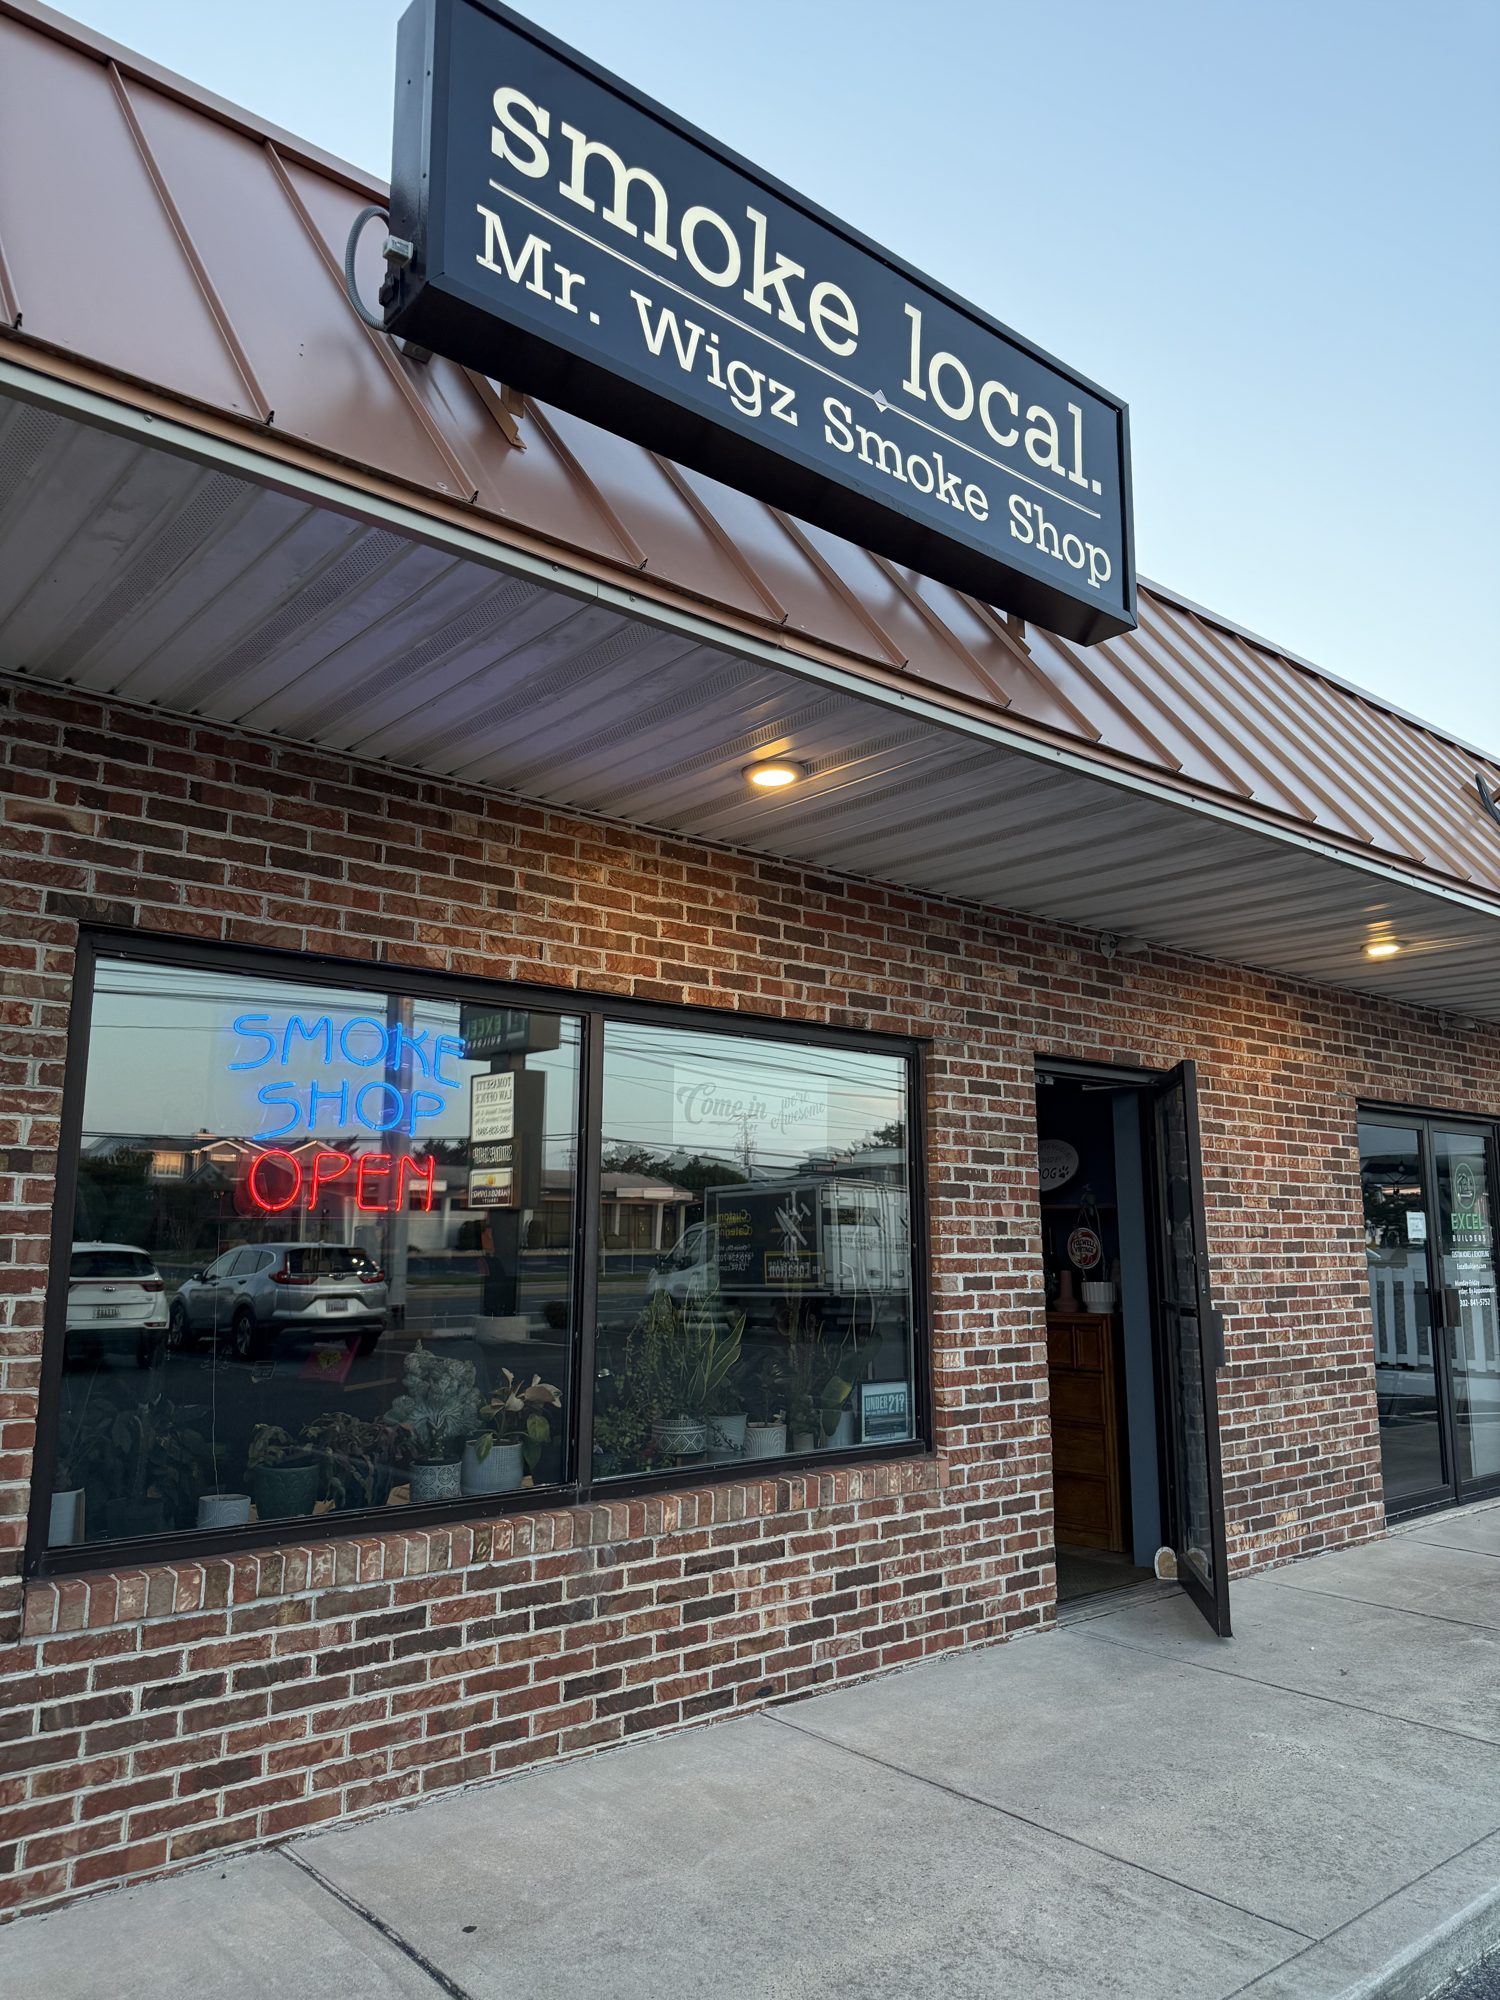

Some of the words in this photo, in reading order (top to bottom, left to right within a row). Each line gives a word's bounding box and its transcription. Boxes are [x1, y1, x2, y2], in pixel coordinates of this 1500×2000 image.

[490, 86, 860, 358] smoke
[902, 302, 1102, 495] local.
[476, 204, 600, 325] Mr.
[631, 290, 798, 427] Wigz
[823, 396, 989, 523] Smoke
[1008, 494, 1112, 586] Shop
[227, 1014, 465, 1088] SMOKE
[253, 1078, 446, 1142] SHOP
[676, 1082, 743, 1124] Come
[747, 1095, 767, 1120] in
[249, 1148, 435, 1212] OPEN
[1450, 1213, 1485, 1230] EXCEL
[865, 1396, 888, 1411] UNDER
[888, 1393, 905, 1413] 21?
